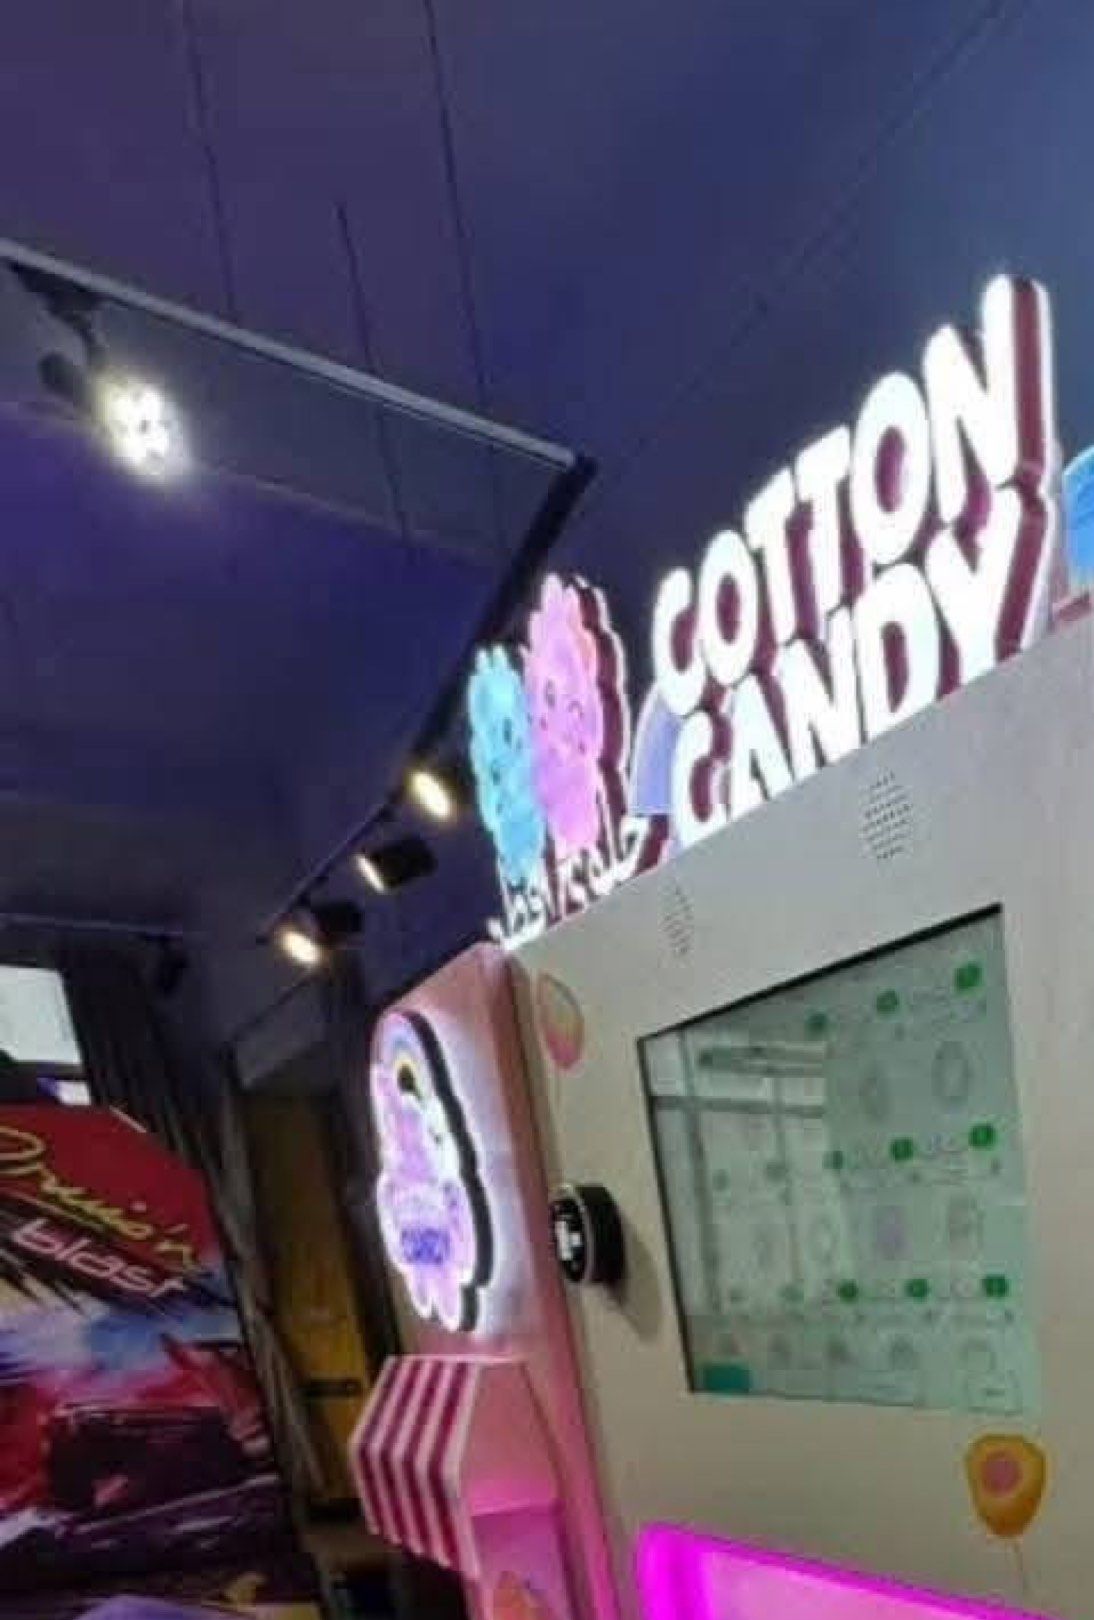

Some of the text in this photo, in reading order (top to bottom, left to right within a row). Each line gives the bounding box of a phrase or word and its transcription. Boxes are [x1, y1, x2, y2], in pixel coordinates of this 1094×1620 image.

[653, 273, 1022, 718] COTTON
[668, 488, 1024, 858] CANDY
[12, 1218, 187, 1298] blast
